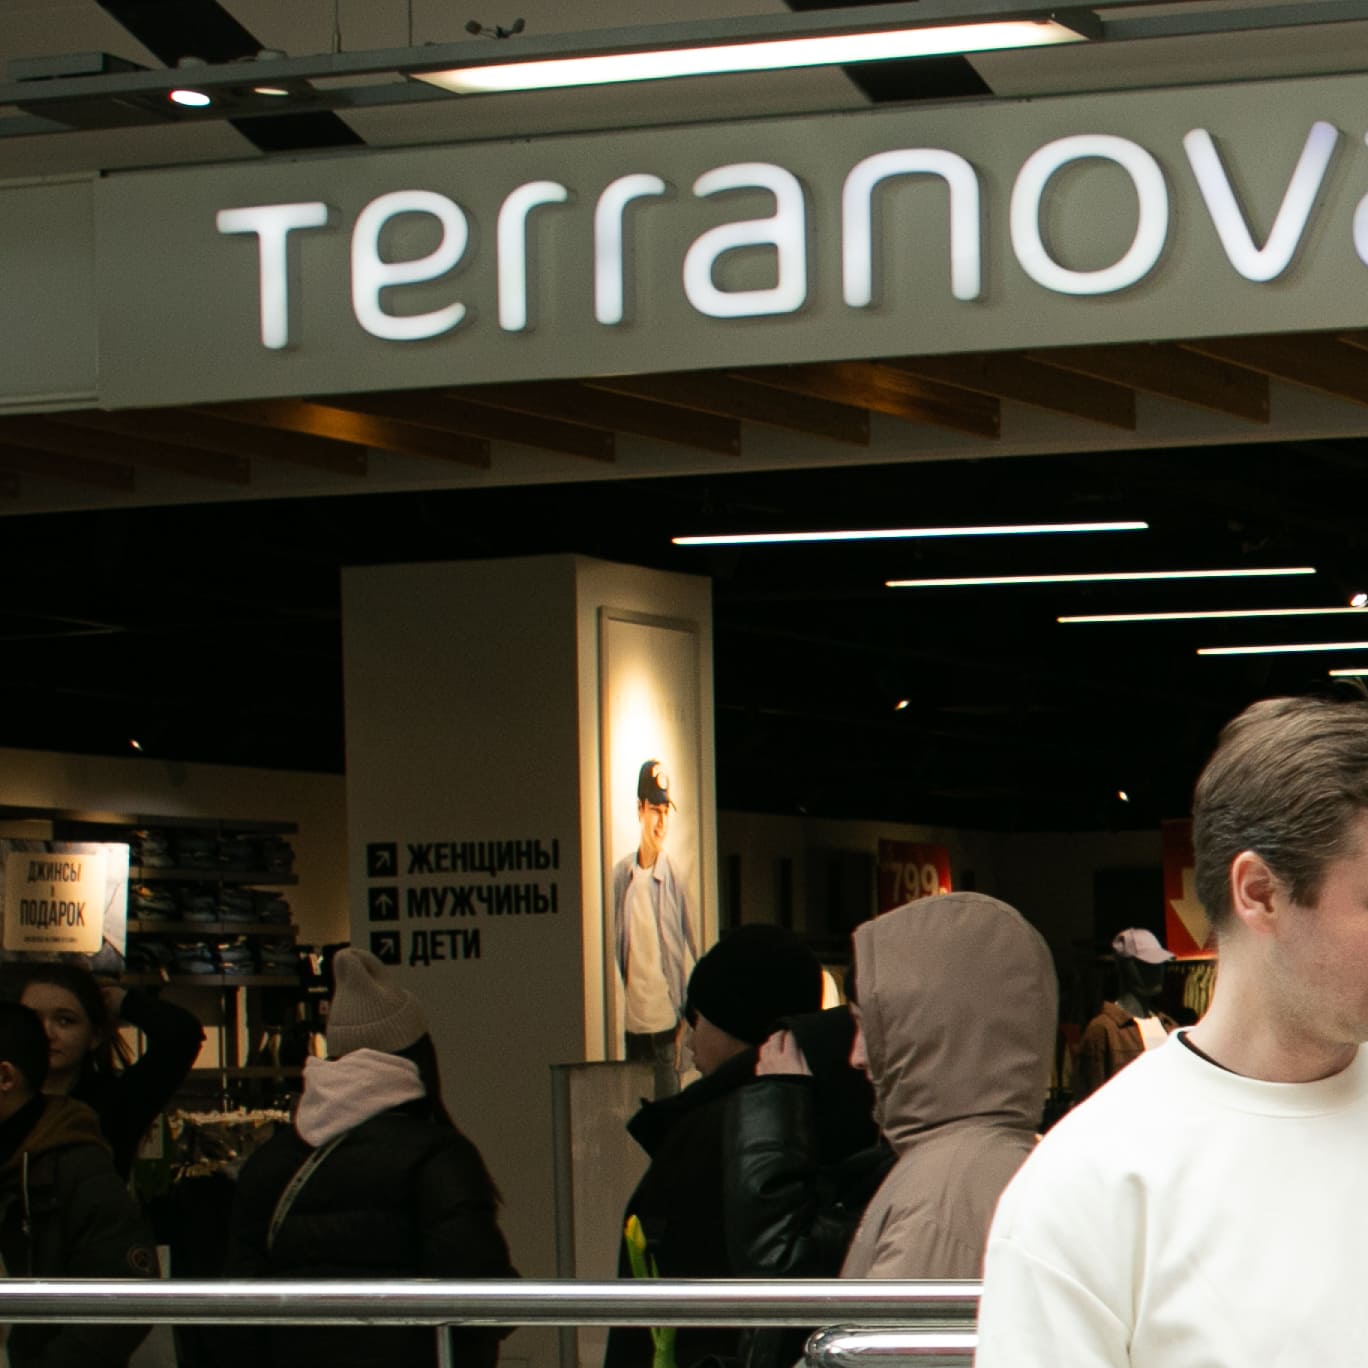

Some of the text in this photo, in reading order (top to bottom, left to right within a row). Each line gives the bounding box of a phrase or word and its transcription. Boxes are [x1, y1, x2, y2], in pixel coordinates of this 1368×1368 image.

[28, 861, 82, 882] ДЖИНСЫ
[407, 839, 560, 876] ЖЕНЩИНЫ
[19, 899, 87, 928] ПОДАРОК
[406, 883, 558, 918] МУЖЧИНЫ
[409, 929, 481, 967] ДЕТИ
